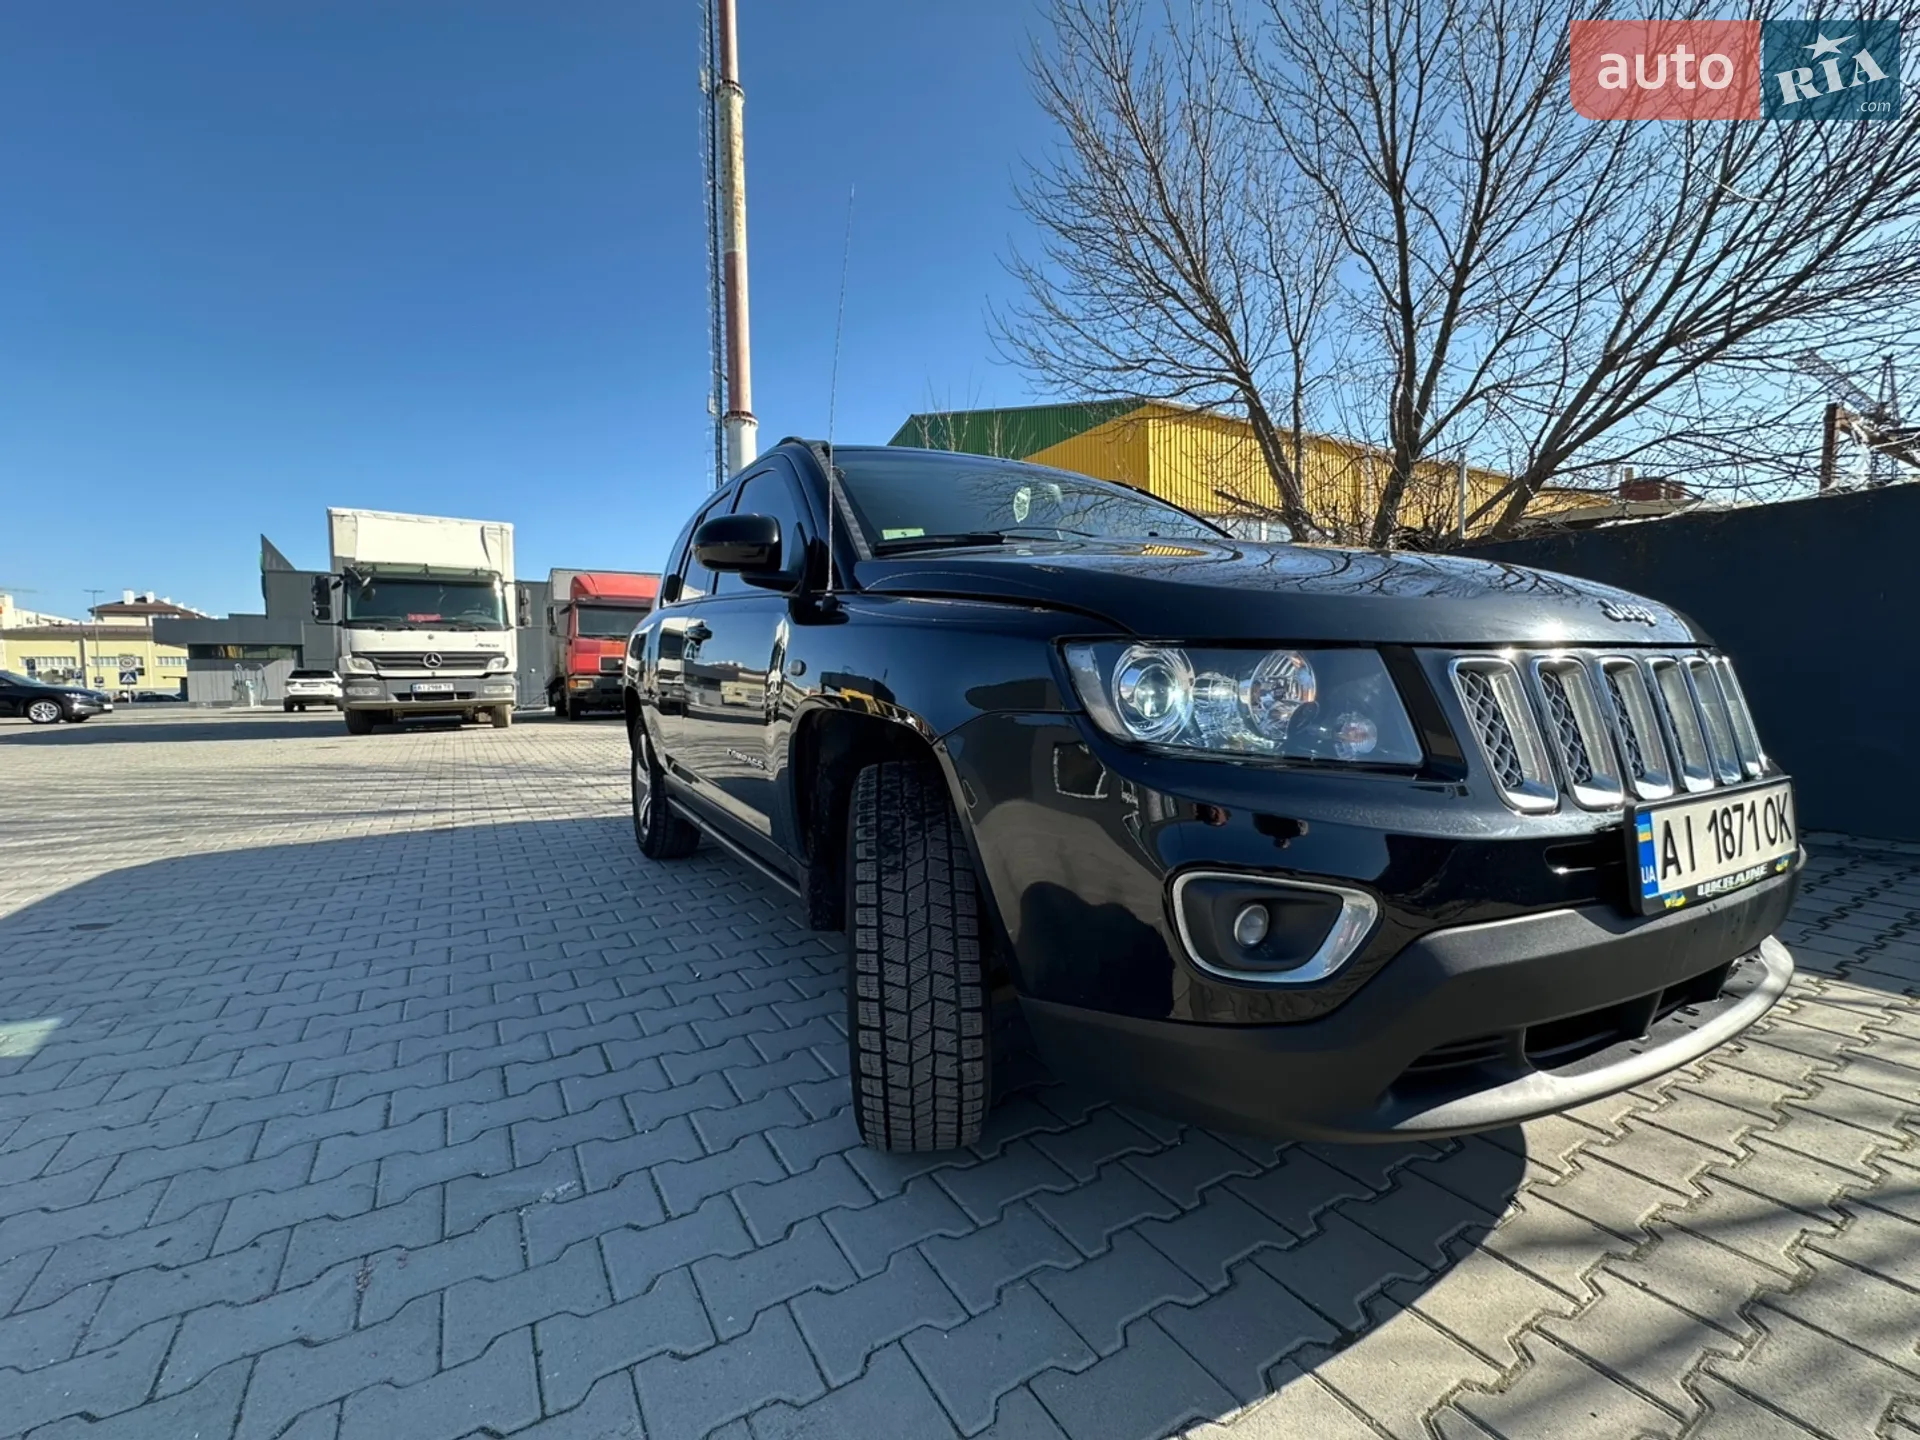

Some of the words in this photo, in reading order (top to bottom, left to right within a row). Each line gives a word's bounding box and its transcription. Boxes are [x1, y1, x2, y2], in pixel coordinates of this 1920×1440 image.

[1598, 598, 1656, 626] Jeep
[1661, 815, 1695, 880] AI
[1707, 800, 1760, 864] 1871
[1763, 792, 1792, 847] OK
[1641, 866, 1657, 884] UA
[1697, 863, 1768, 896] UKRAINE
